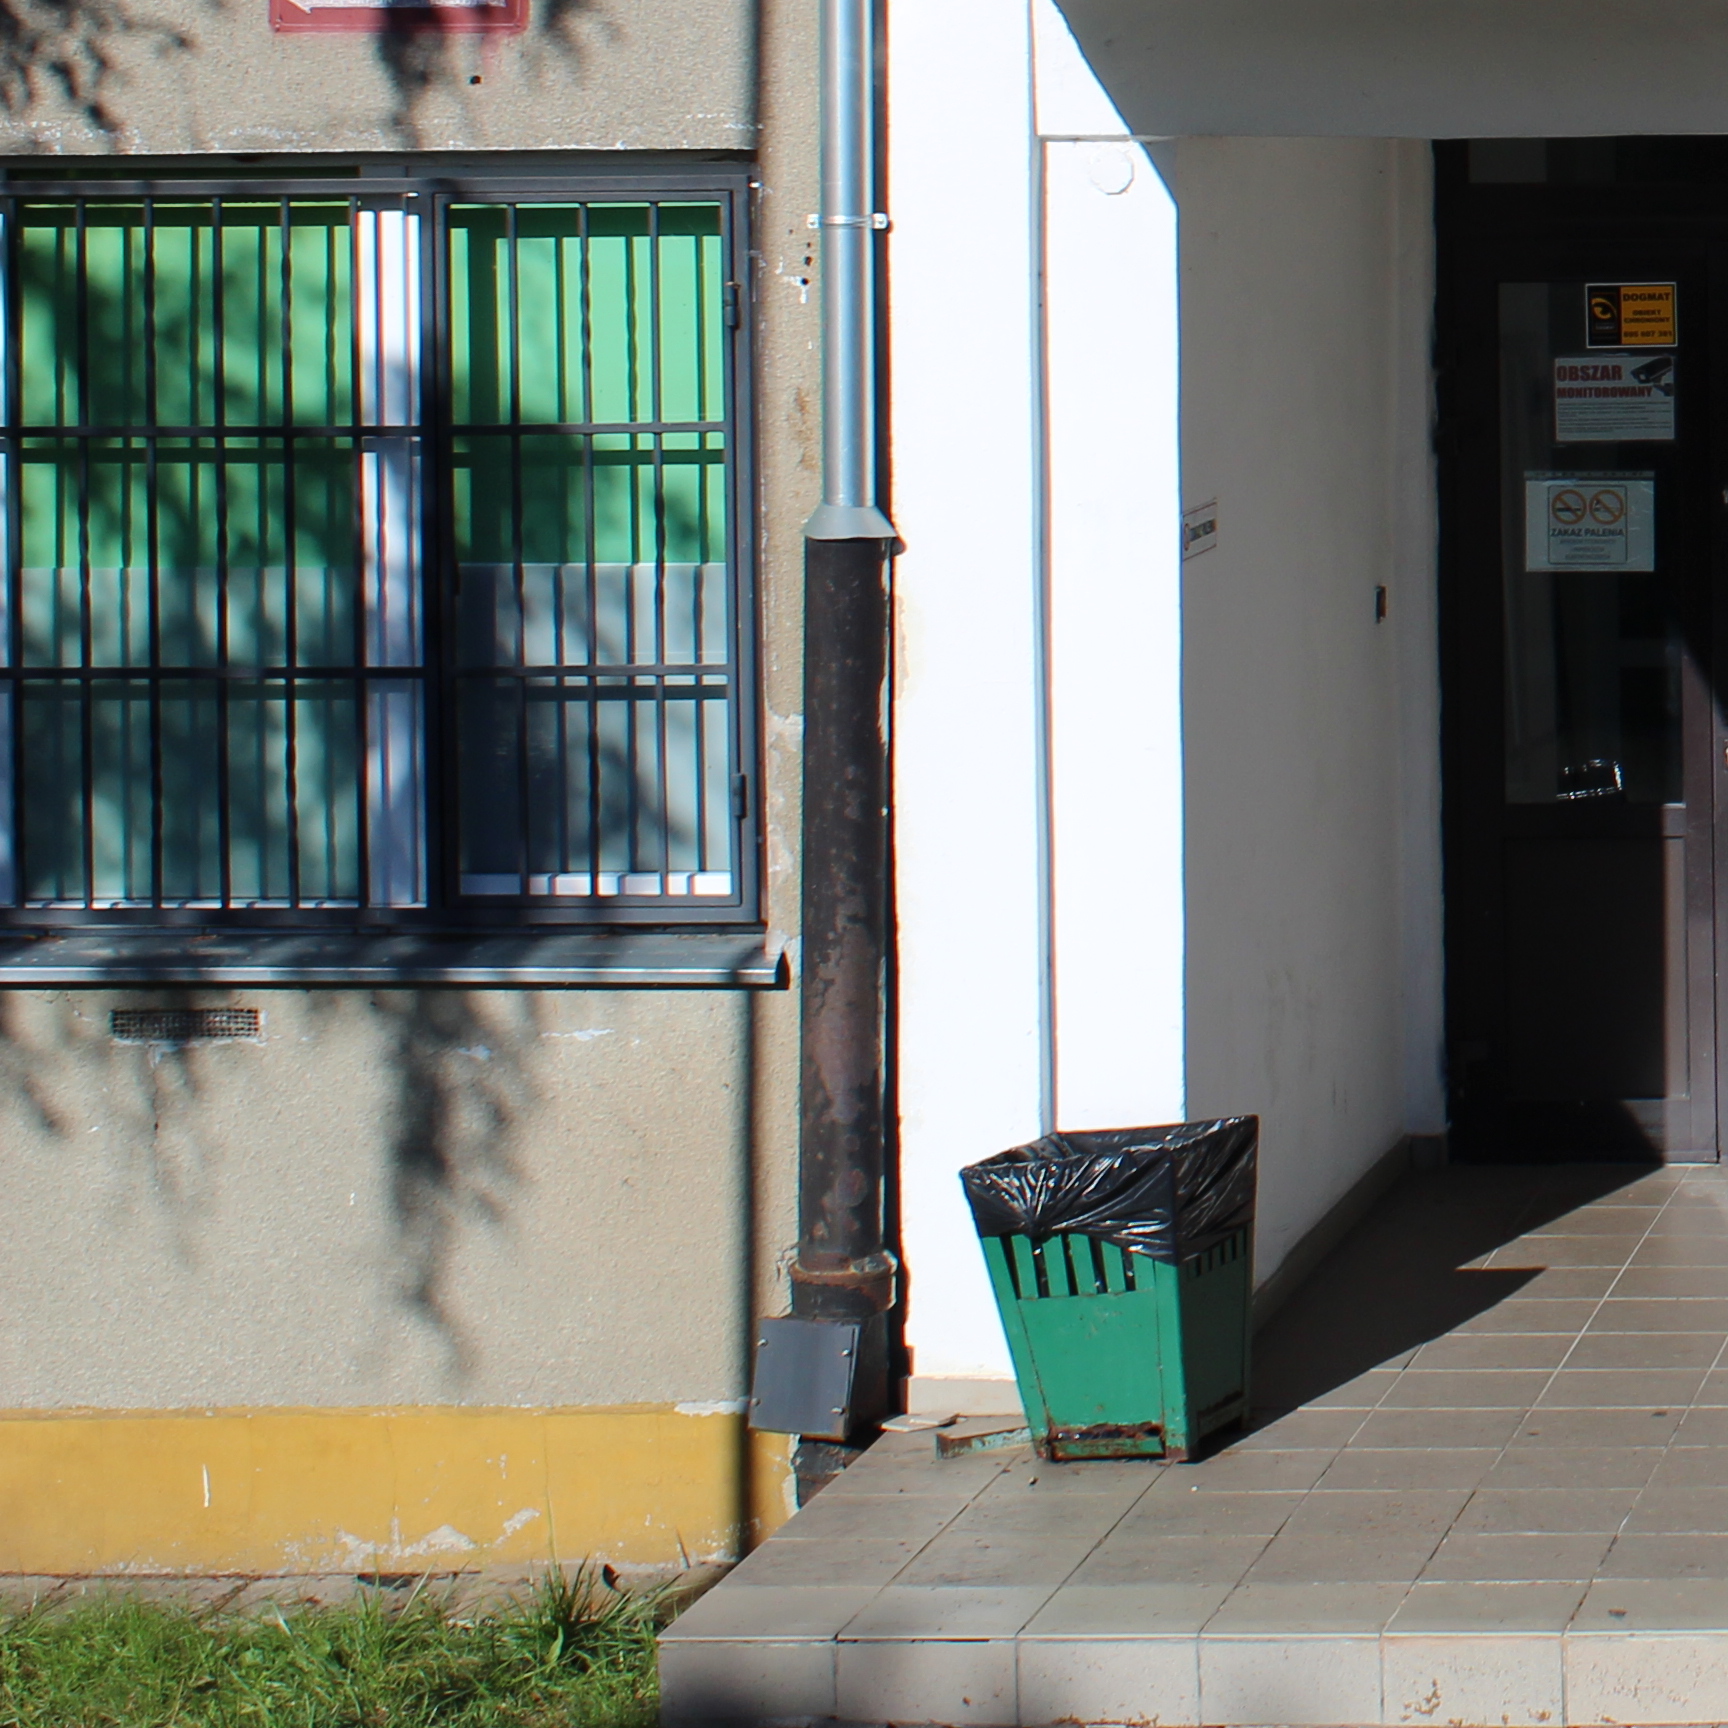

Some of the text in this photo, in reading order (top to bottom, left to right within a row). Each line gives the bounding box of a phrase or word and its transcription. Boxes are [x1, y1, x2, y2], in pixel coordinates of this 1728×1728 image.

[1622, 292, 1671, 302] DOGMAT
[1556, 365, 1623, 382] OBSZAR
[1556, 386, 1653, 399] MONITOROWANY
[1551, 527, 1625, 537] ZAKAZ PALENIA
